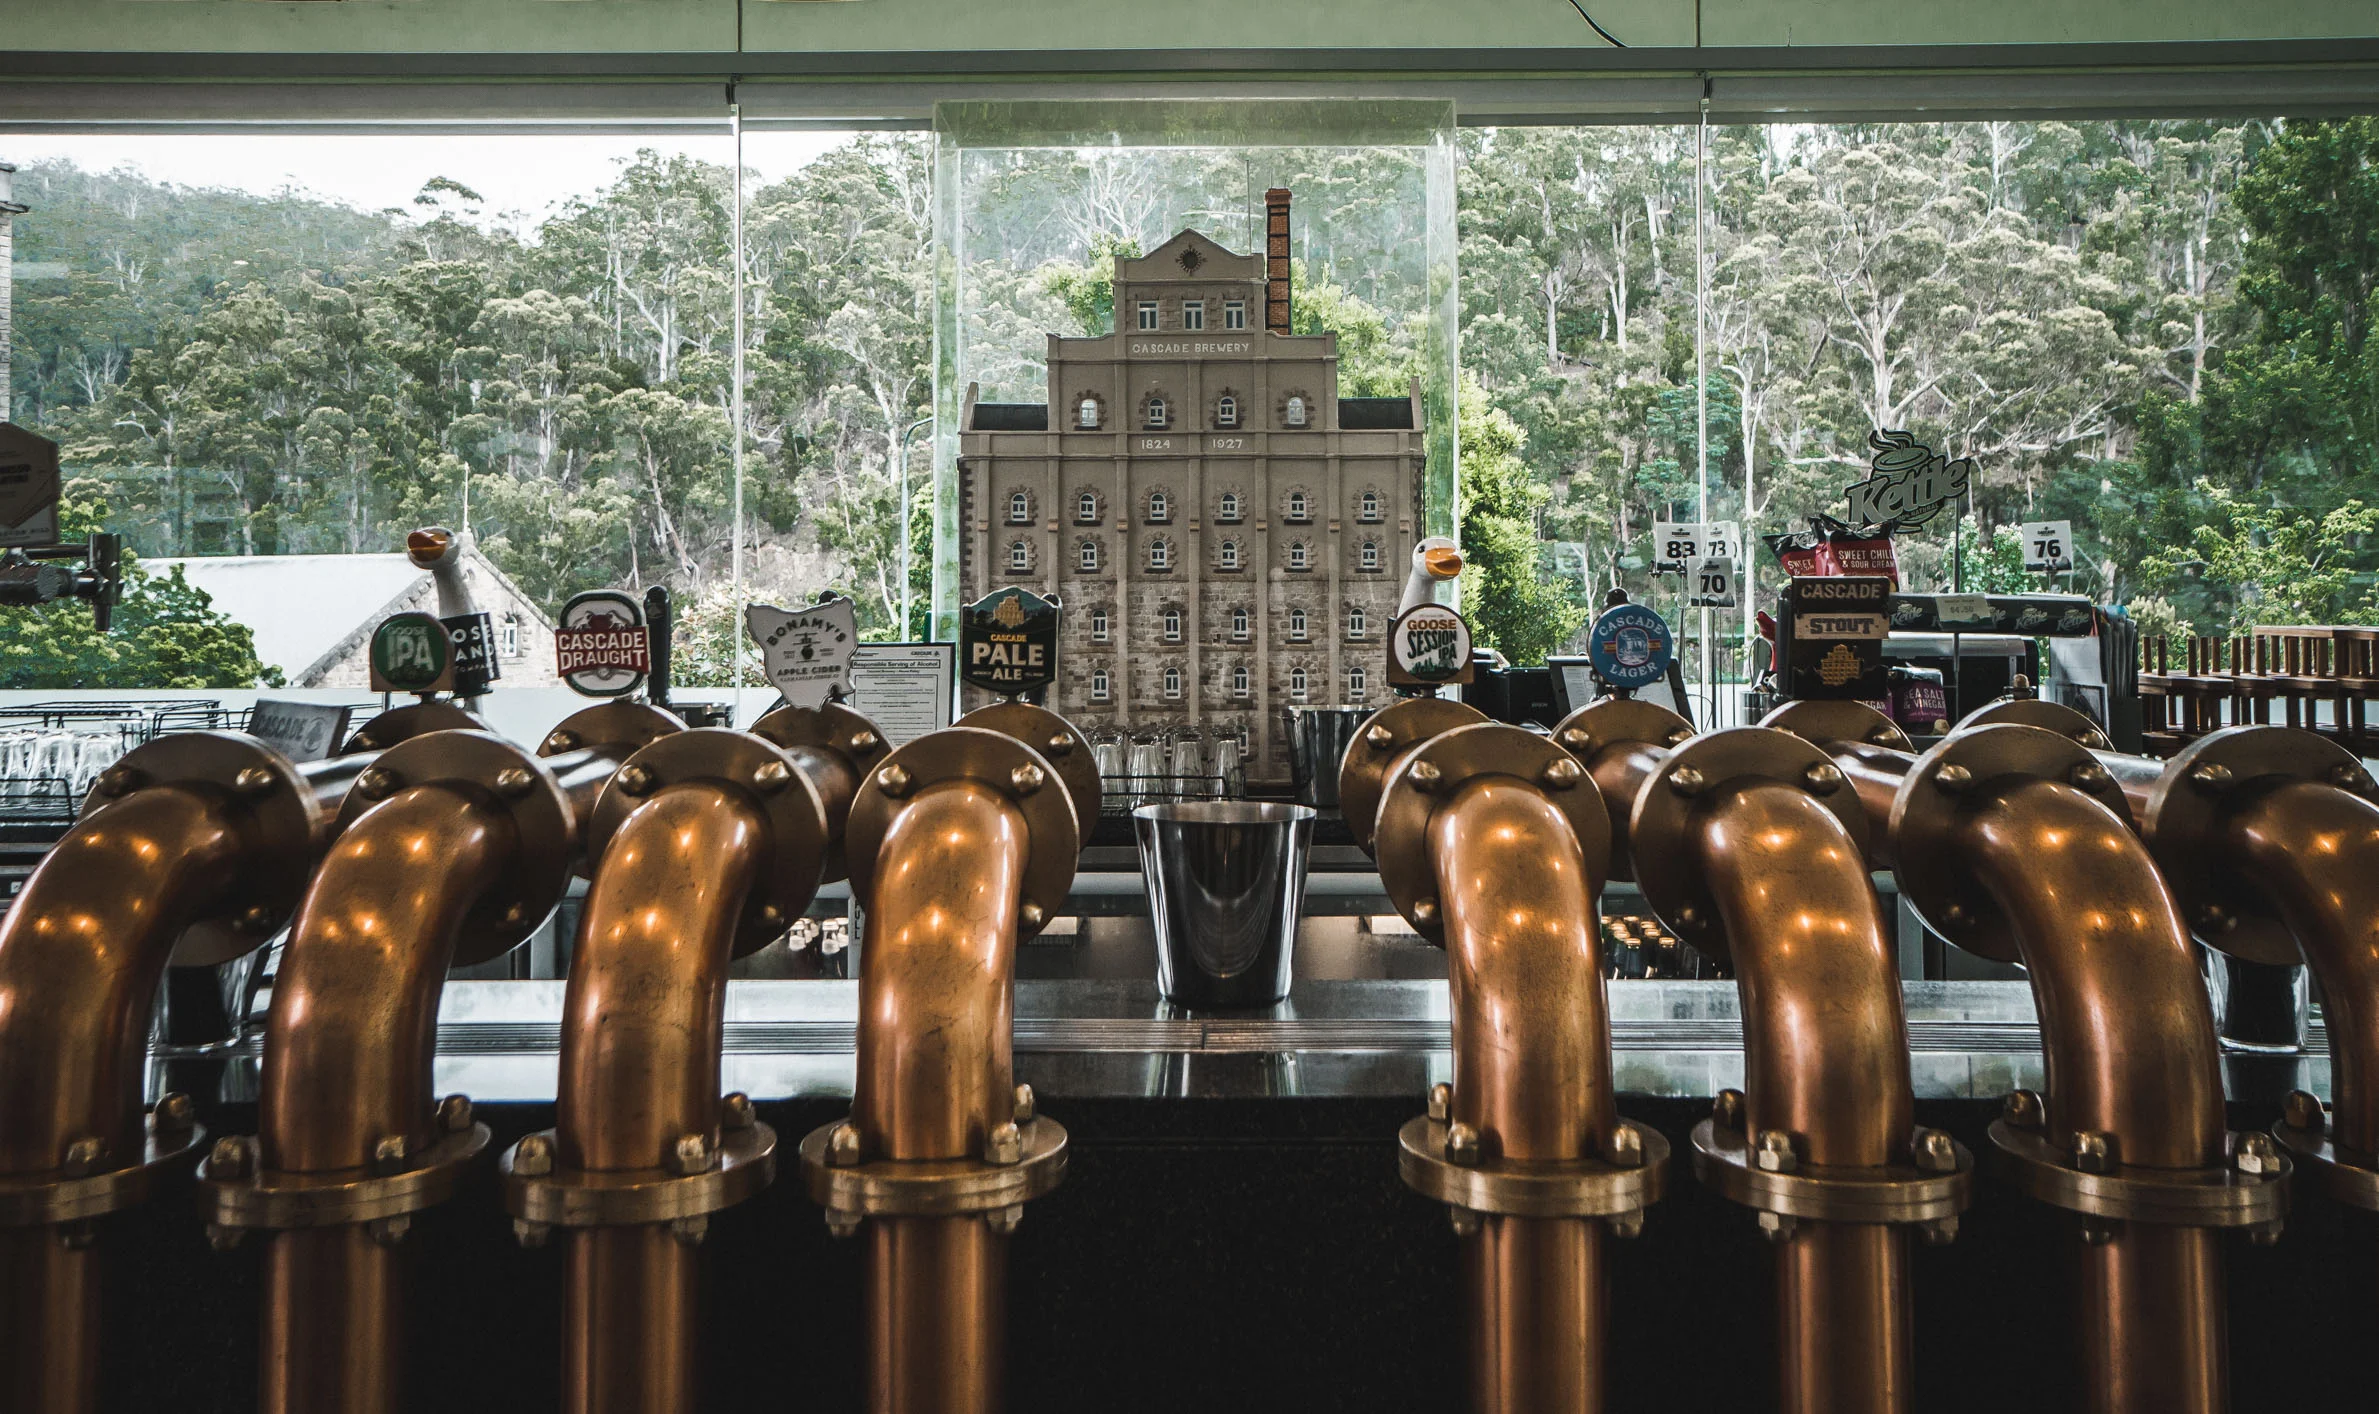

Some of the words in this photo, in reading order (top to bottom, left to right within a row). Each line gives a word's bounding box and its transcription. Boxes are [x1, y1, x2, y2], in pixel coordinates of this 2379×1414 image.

[1132, 344, 1190, 354] CASCADE
[1194, 343, 1250, 353] BREWERY
[1141, 439, 1171, 449] 1824
[1212, 438, 1243, 449] 1927
[1845, 457, 1970, 525] Kettle
[1666, 541, 1696, 558] 83
[1708, 540, 1726, 556] 73
[1838, 550, 1867, 560] SWEET
[1870, 549, 1894, 560] CHILL
[2033, 539, 2062, 558] 76
[1842, 560, 1849, 568] &
[1850, 560, 1869, 568] SOUR
[1701, 574, 1726, 593] 70
[1801, 583, 1881, 599] CASCADE
[766, 617, 847, 646] BONAMY'S
[1406, 619, 1457, 630] GOOSE
[1598, 615, 1665, 636] CASCADE
[1810, 618, 1875, 634] STOUT
[448, 624, 492, 643] OSE
[558, 631, 645, 650] CASCADE
[990, 633, 1027, 642] CASCADE
[1406, 630, 1458, 659] SESSION
[1438, 642, 1458, 660] IPA
[387, 635, 436, 671] IPA
[559, 650, 645, 670] DRAUGHT
[972, 642, 1045, 666] PALE
[777, 667, 809, 676] APPLE
[811, 664, 842, 674] CIDER
[992, 668, 1023, 680] ALE
[1609, 662, 1659, 678] LAGER
[1903, 687, 1922, 699] SEA
[1923, 688, 1945, 700] SALT
